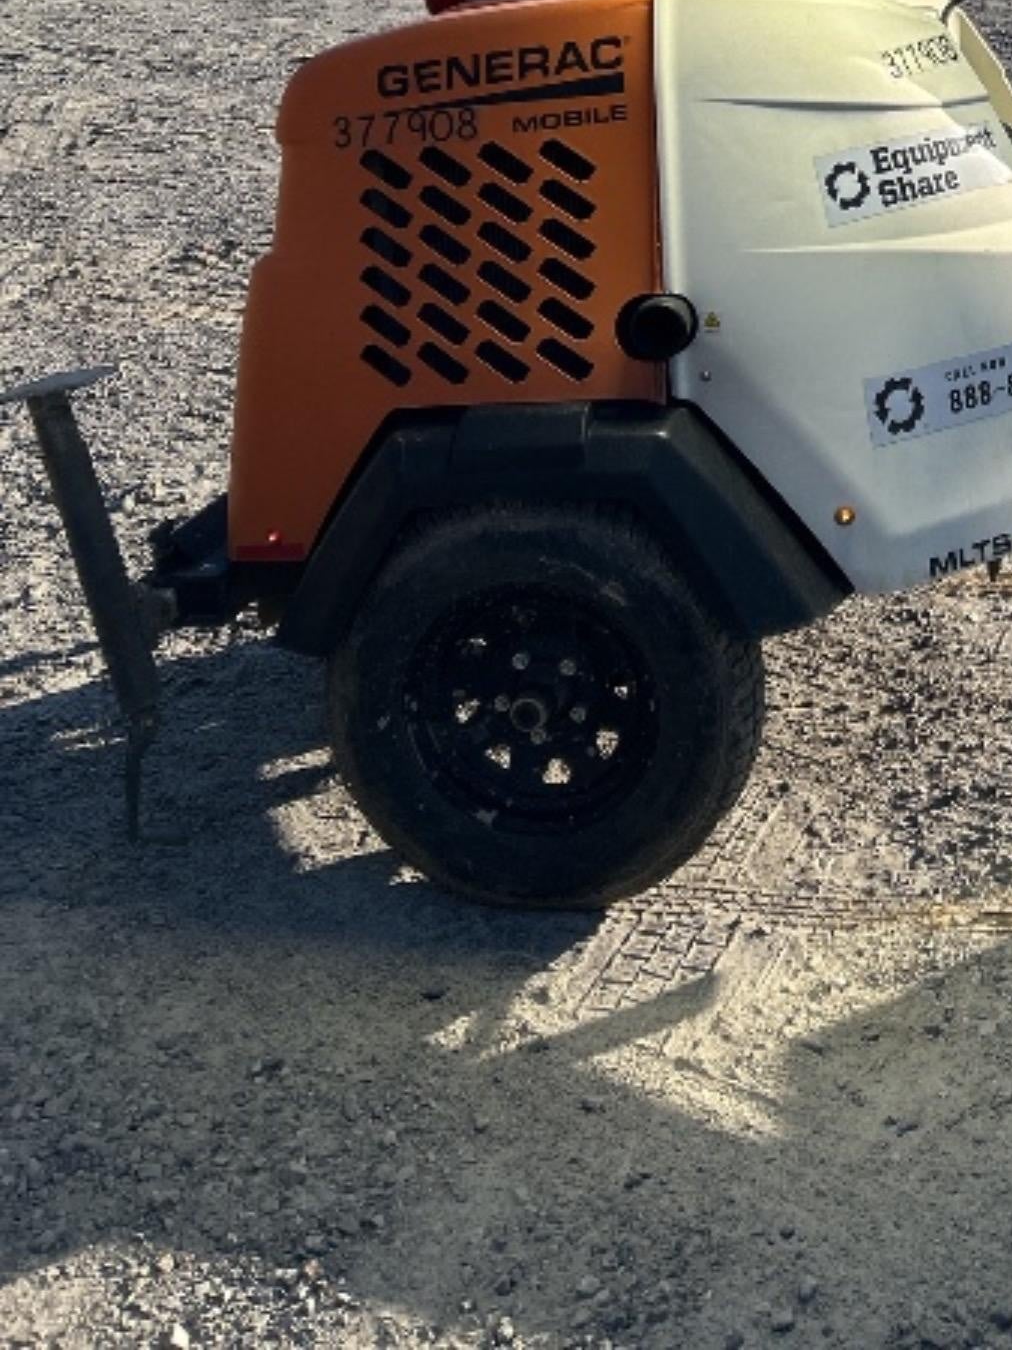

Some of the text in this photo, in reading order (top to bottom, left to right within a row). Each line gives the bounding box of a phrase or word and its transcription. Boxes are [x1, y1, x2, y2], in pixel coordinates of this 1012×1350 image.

[376, 35, 624, 98] GENERAC
[332, 106, 479, 149] 377908
[512, 104, 628, 134] MOBILE
[879, 170, 960, 206] Share
